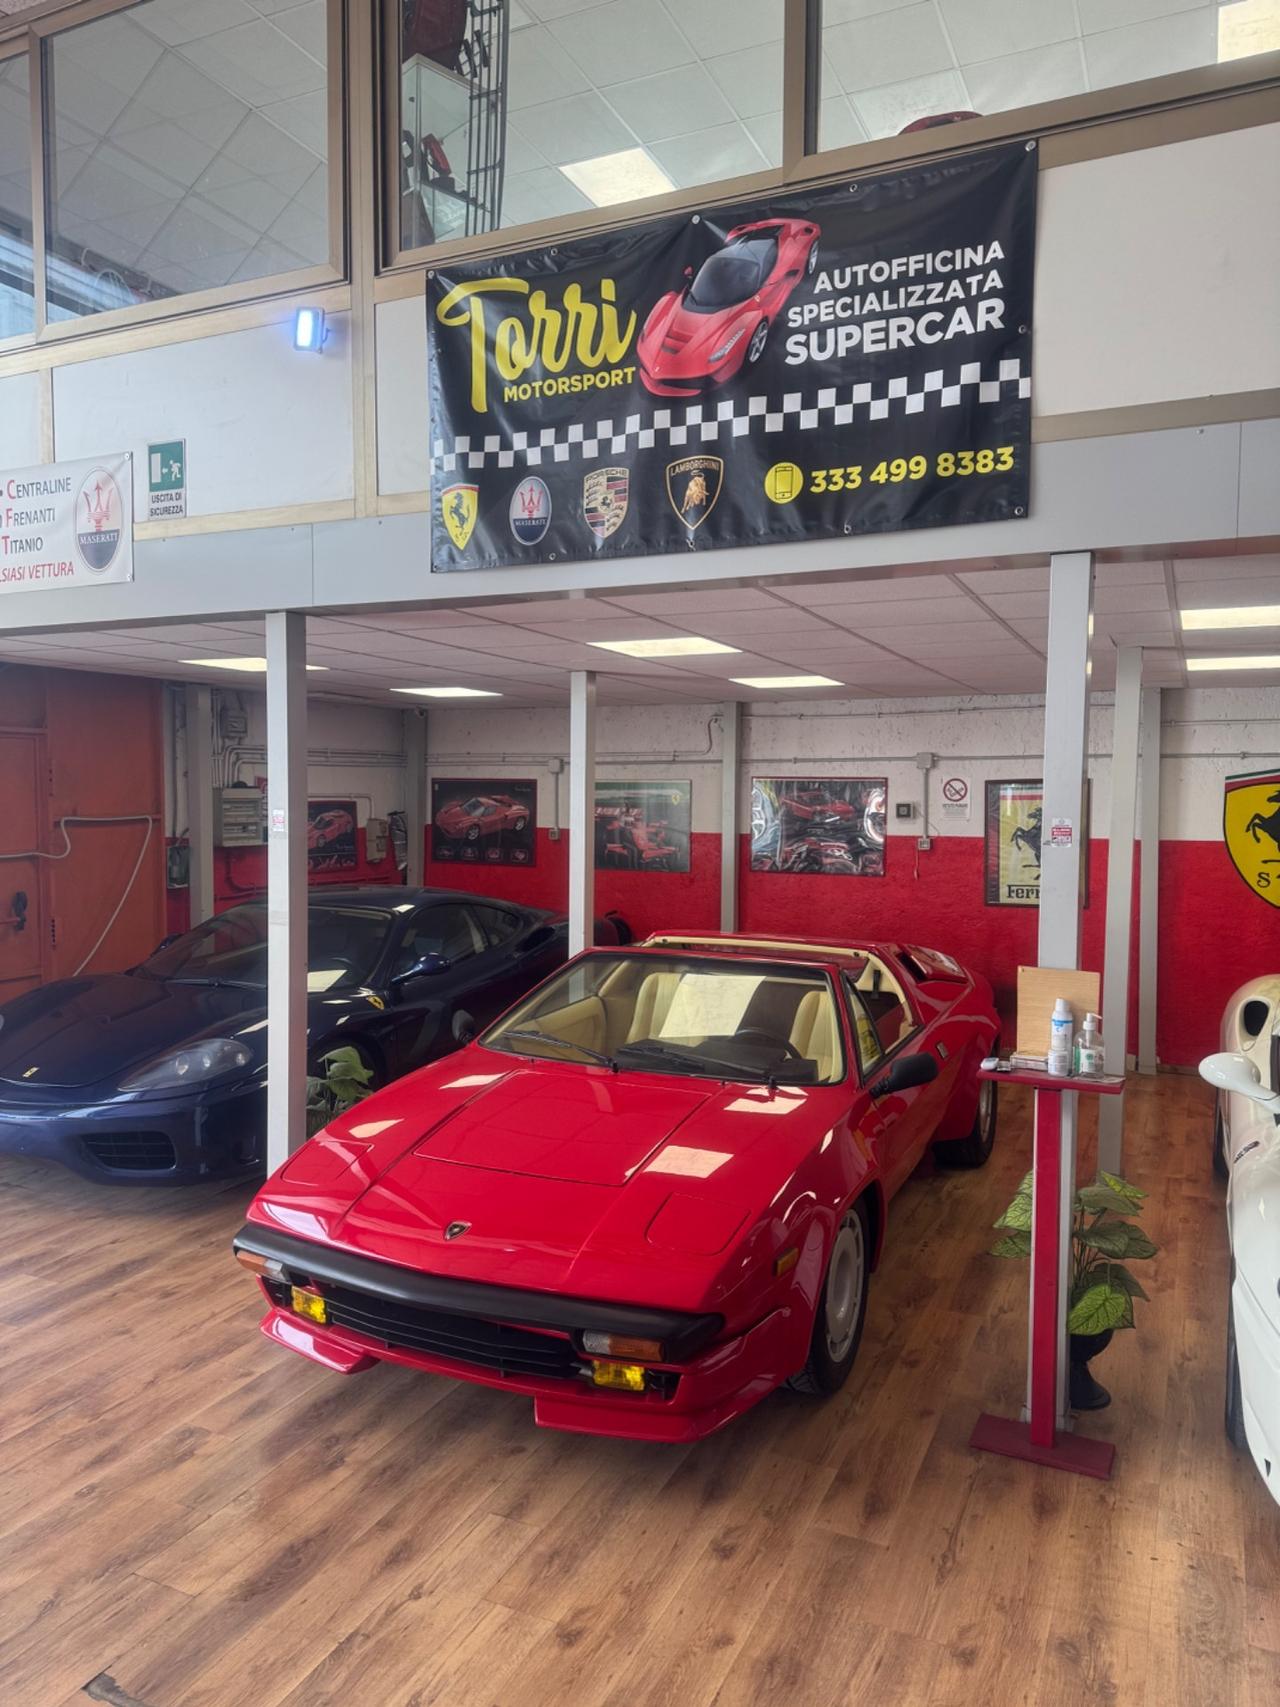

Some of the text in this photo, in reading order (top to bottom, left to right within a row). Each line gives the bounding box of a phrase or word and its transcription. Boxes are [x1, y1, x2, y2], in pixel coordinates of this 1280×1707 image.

[813, 240, 1005, 294] AUTOFFICINA
[787, 269, 1004, 328] SPECIALIZZATA
[785, 297, 1006, 366] SUPERCAR
[436, 277, 637, 413] Torri
[504, 366, 636, 403] MOTORSPORT
[809, 446, 1015, 493] 333 499 8383
[7, 477, 71, 499] CENTRALINE
[151, 492, 182, 503] USCITA DI
[5, 507, 56, 528] FRENANTI
[150, 504, 184, 517] SICUREZZA
[1, 535, 44, 555] TITANIO
[80, 533, 118, 544] MASERATI
[0, 561, 74, 583] SIASI VETTURA
[1006, 884, 1041, 899] Ferr
